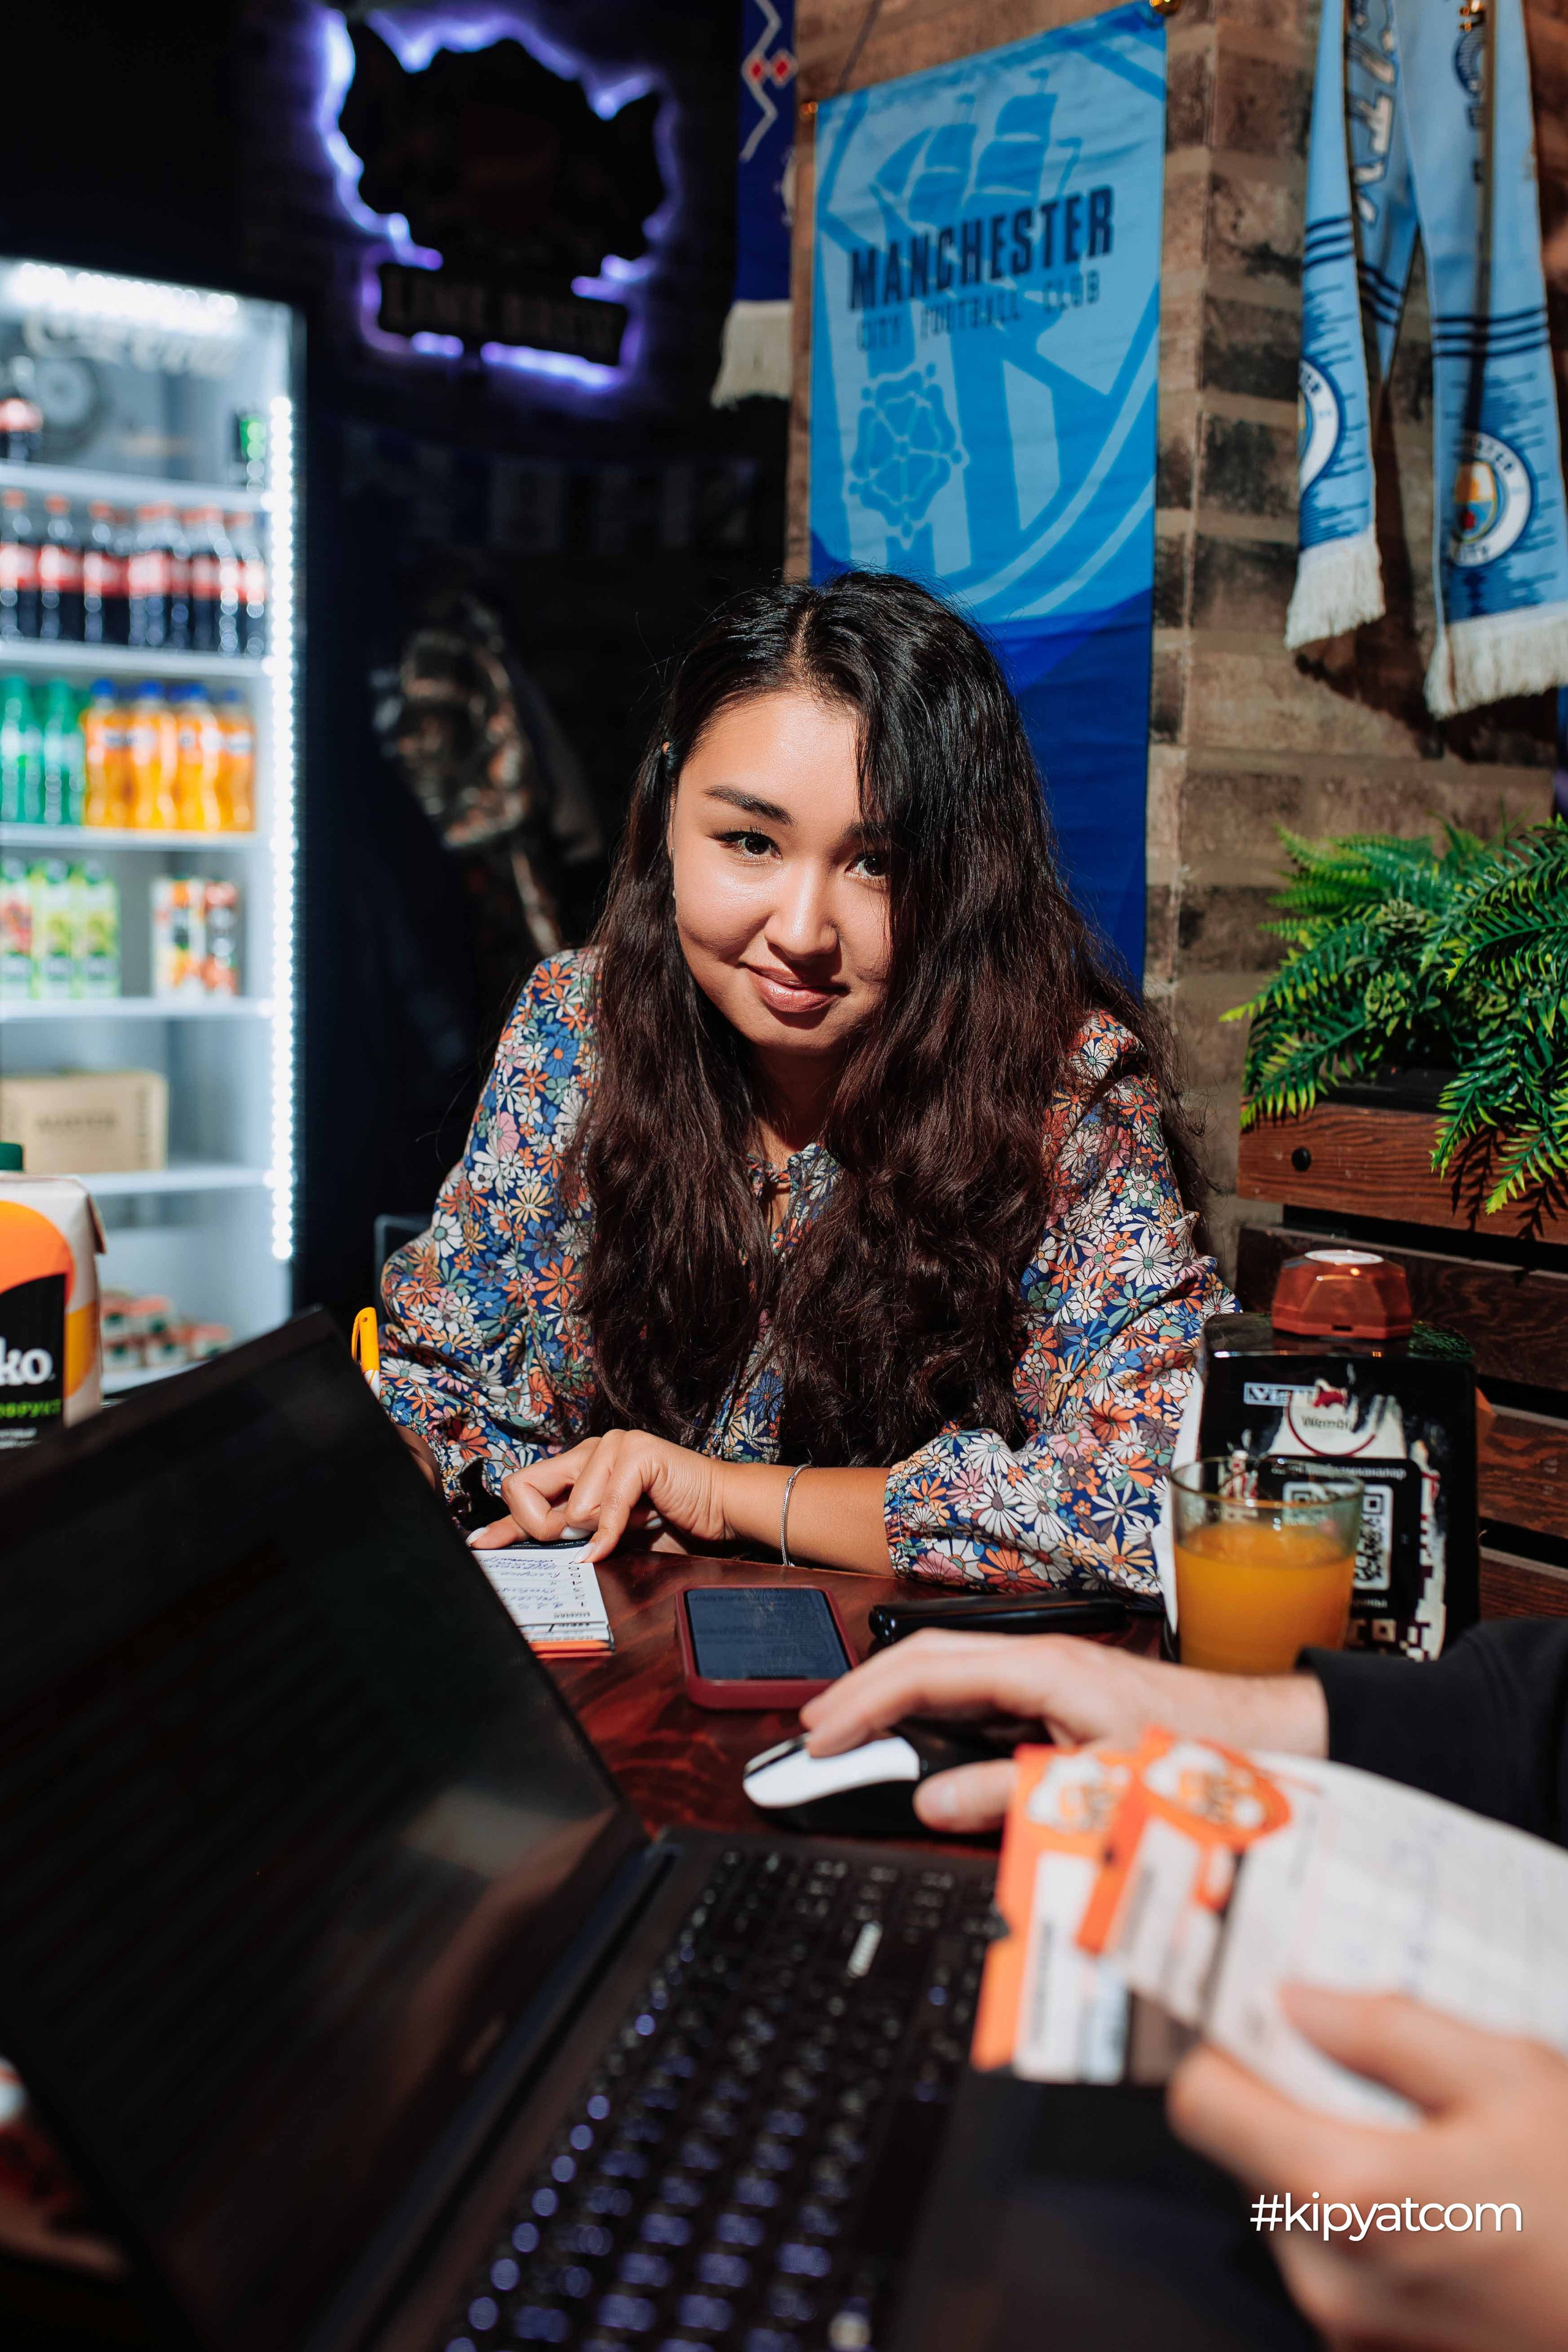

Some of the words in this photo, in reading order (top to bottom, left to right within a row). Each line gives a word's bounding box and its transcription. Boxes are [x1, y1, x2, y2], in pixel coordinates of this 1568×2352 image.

[849, 184, 1114, 312] MANCHESTER
[856, 314, 902, 352] CITY
[921, 288, 1022, 339] FOOTBALL
[1043, 270, 1101, 315] CLUB
[1301, 1414, 1351, 1430] Wembl
